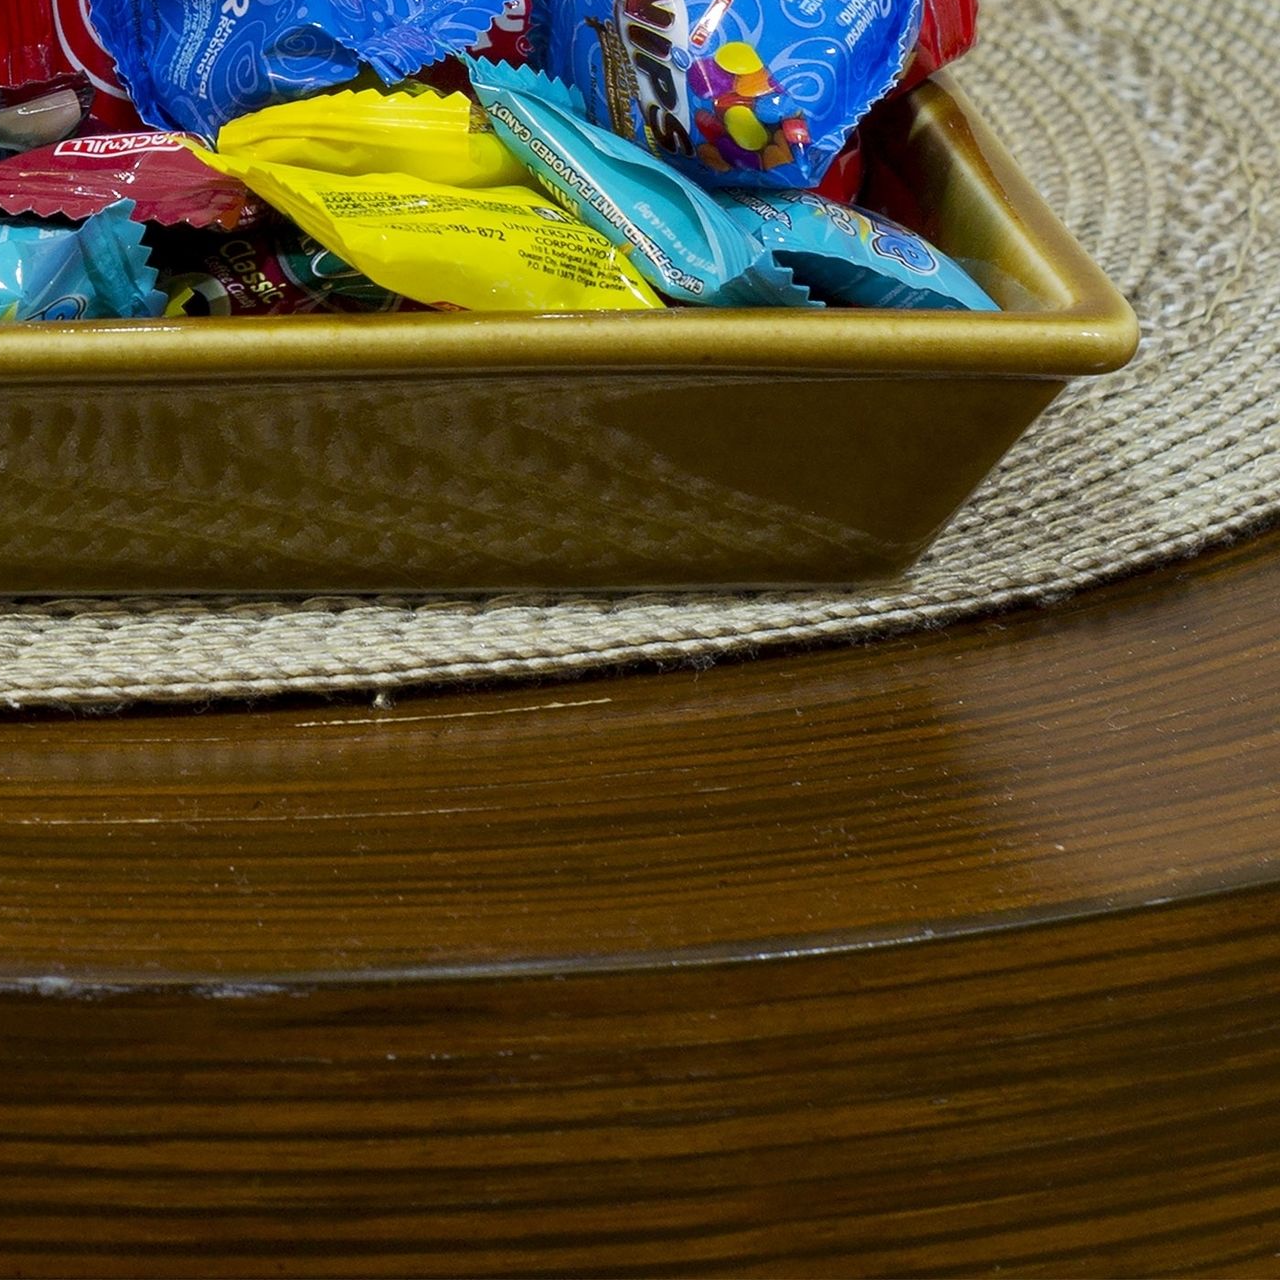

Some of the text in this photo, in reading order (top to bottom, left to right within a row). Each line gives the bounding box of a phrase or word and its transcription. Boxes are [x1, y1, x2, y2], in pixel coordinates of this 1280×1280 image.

[195, 15, 229, 76] Robina
[844, 1, 880, 53] Universal
[199, 17, 237, 100] Universal
[487, 100, 532, 143] CANDY
[529, 140, 596, 205] FLAVORED
[502, 221, 583, 241] UNIVERSAL
[588, 196, 627, 230] MINT
[220, 239, 285, 304] Classic
[597, 278, 627, 295] Center
